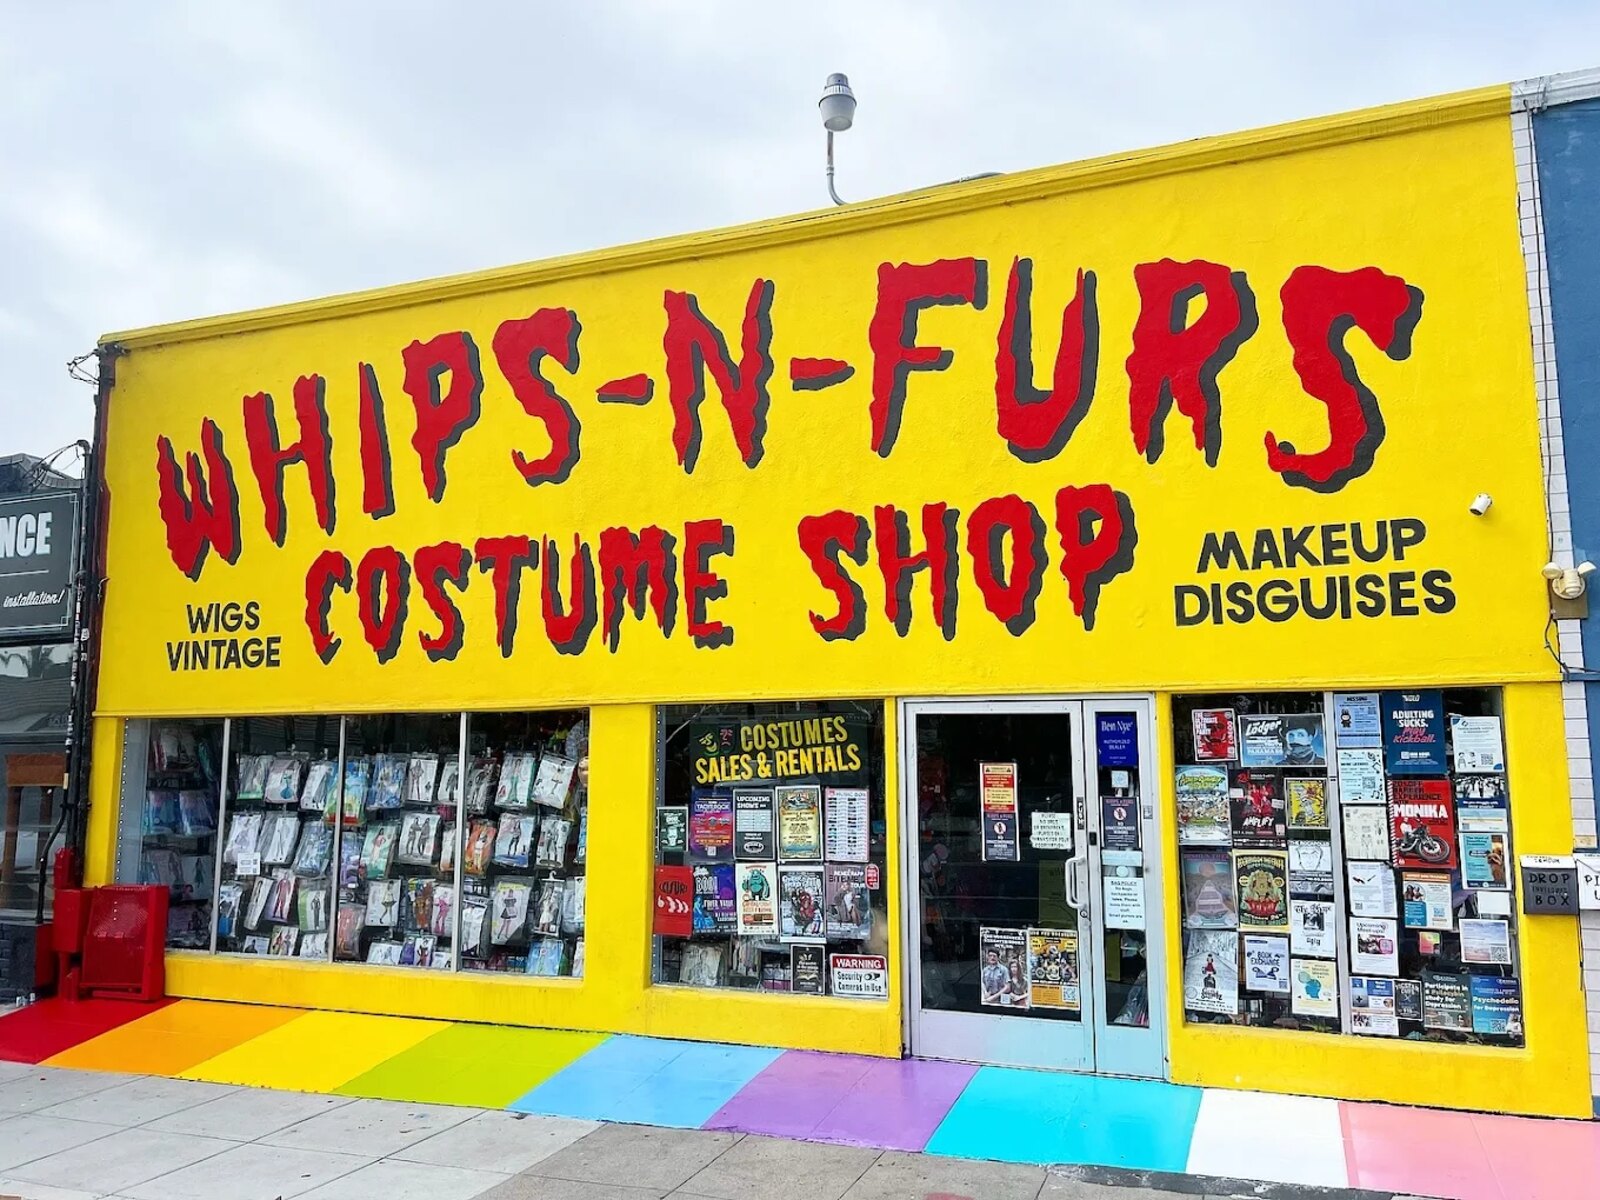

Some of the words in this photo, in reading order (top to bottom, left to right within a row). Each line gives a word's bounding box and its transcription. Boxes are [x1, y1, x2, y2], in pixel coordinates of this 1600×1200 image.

[156, 253, 1425, 583] WHIPS-N-FURS
[0, 511, 53, 559] NCE
[1196, 518, 1426, 573] MAKEUP
[304, 518, 735, 665] COSTUME
[798, 483, 1139, 642] SHOP
[3, 590, 65, 608] installation!
[1174, 570, 1456, 626] DISGUISES
[186, 601, 260, 634] WIGS
[166, 636, 281, 671] VINTAGE
[1392, 710, 1434, 720] ADULTING
[1398, 719, 1429, 728] SUCKS.
[740, 715, 848, 752] COSTUMES
[695, 753, 753, 784] SALES
[757, 752, 772, 779] &
[775, 743, 861, 777] RENTALS
[1393, 804, 1449, 818] MONIKA
[1242, 816, 1275, 827] AMPLIFY
[1529, 873, 1570, 884] DROP
[1536, 895, 1570, 906] BOX
[836, 958, 882, 969] WARNING
[837, 971, 863, 982] Security
[838, 981, 863, 992] Cameras
[871, 983, 882, 993] Use
[1424, 982, 1461, 991] Participate
[1425, 1001, 1462, 1010] Depression
[1473, 996, 1519, 1004] Psychedelic
